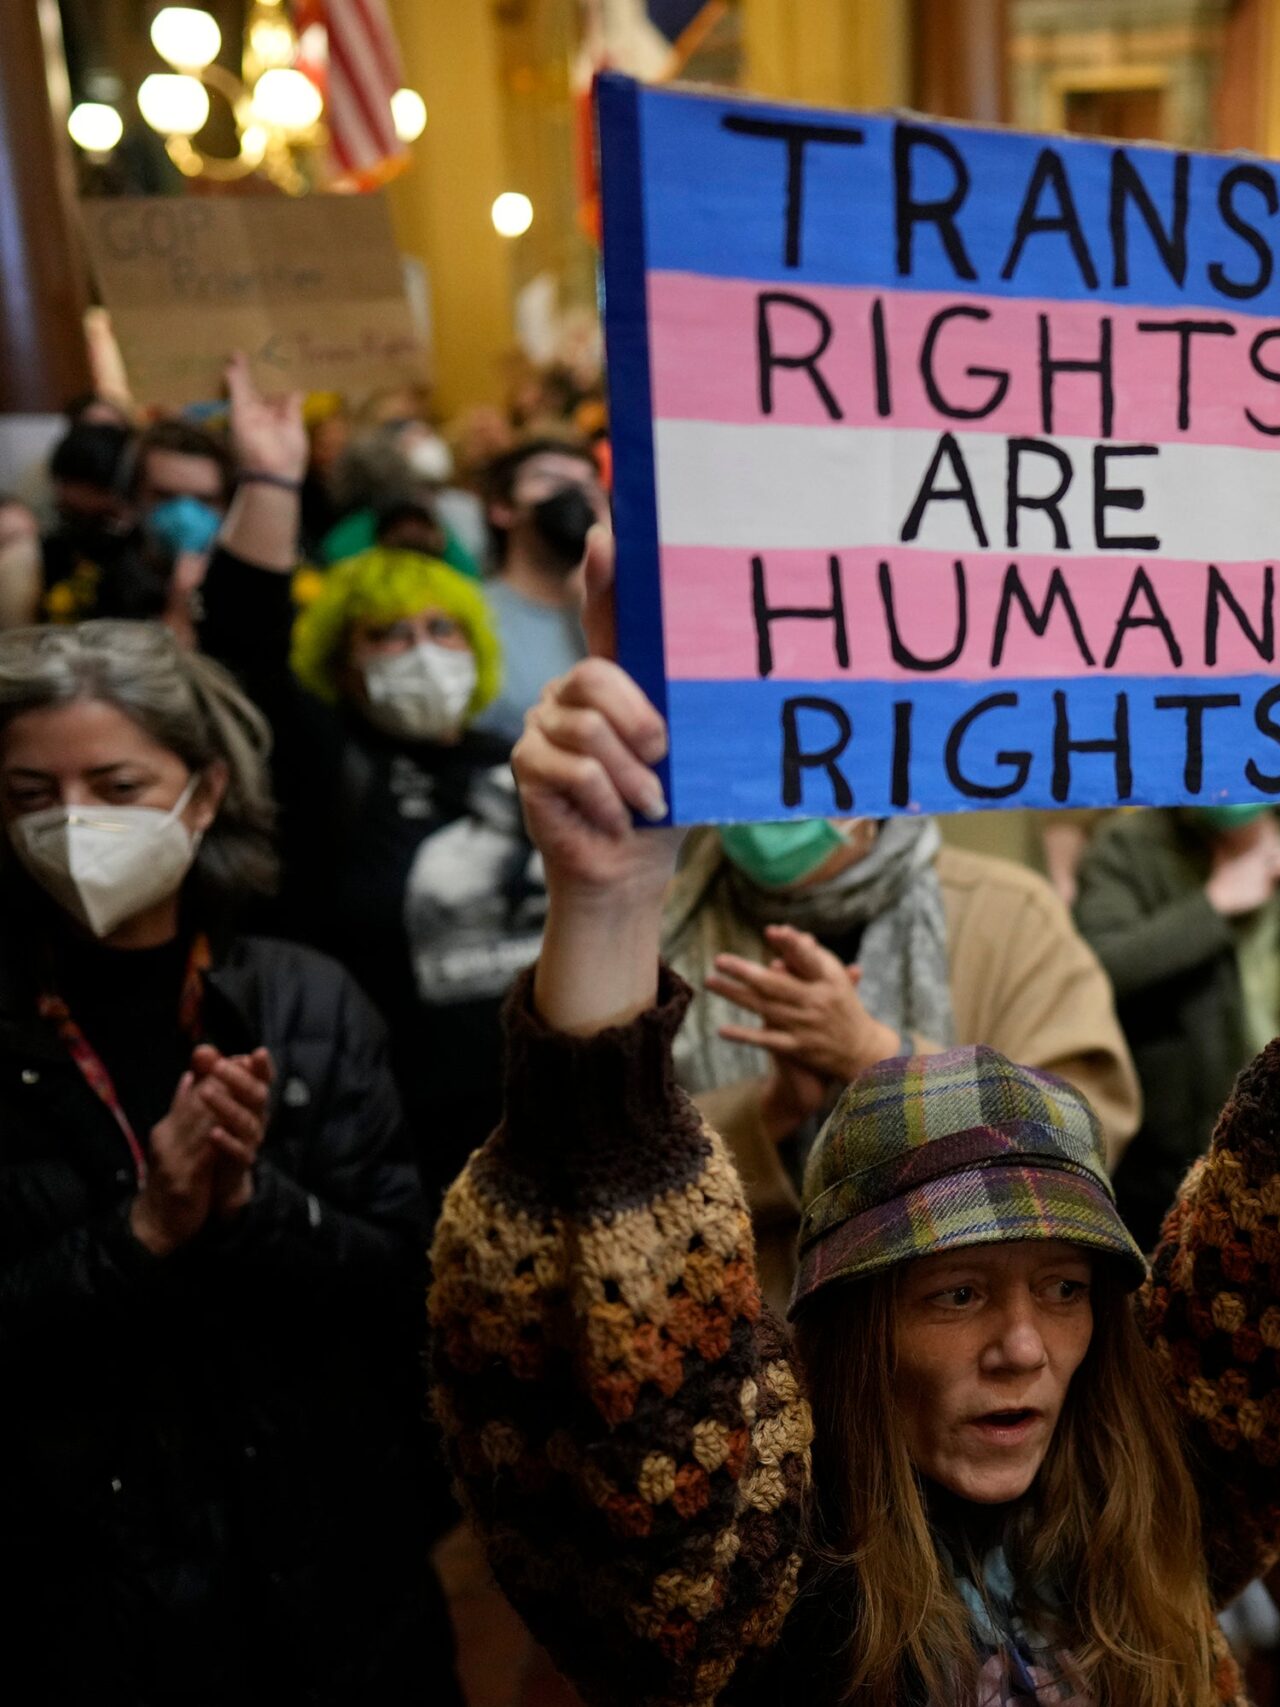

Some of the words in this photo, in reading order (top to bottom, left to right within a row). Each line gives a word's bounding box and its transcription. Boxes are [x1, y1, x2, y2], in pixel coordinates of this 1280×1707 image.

[721, 114, 1280, 300] TRANS
[900, 431, 1161, 550] ARE
[751, 555, 1275, 678] HUMAN
